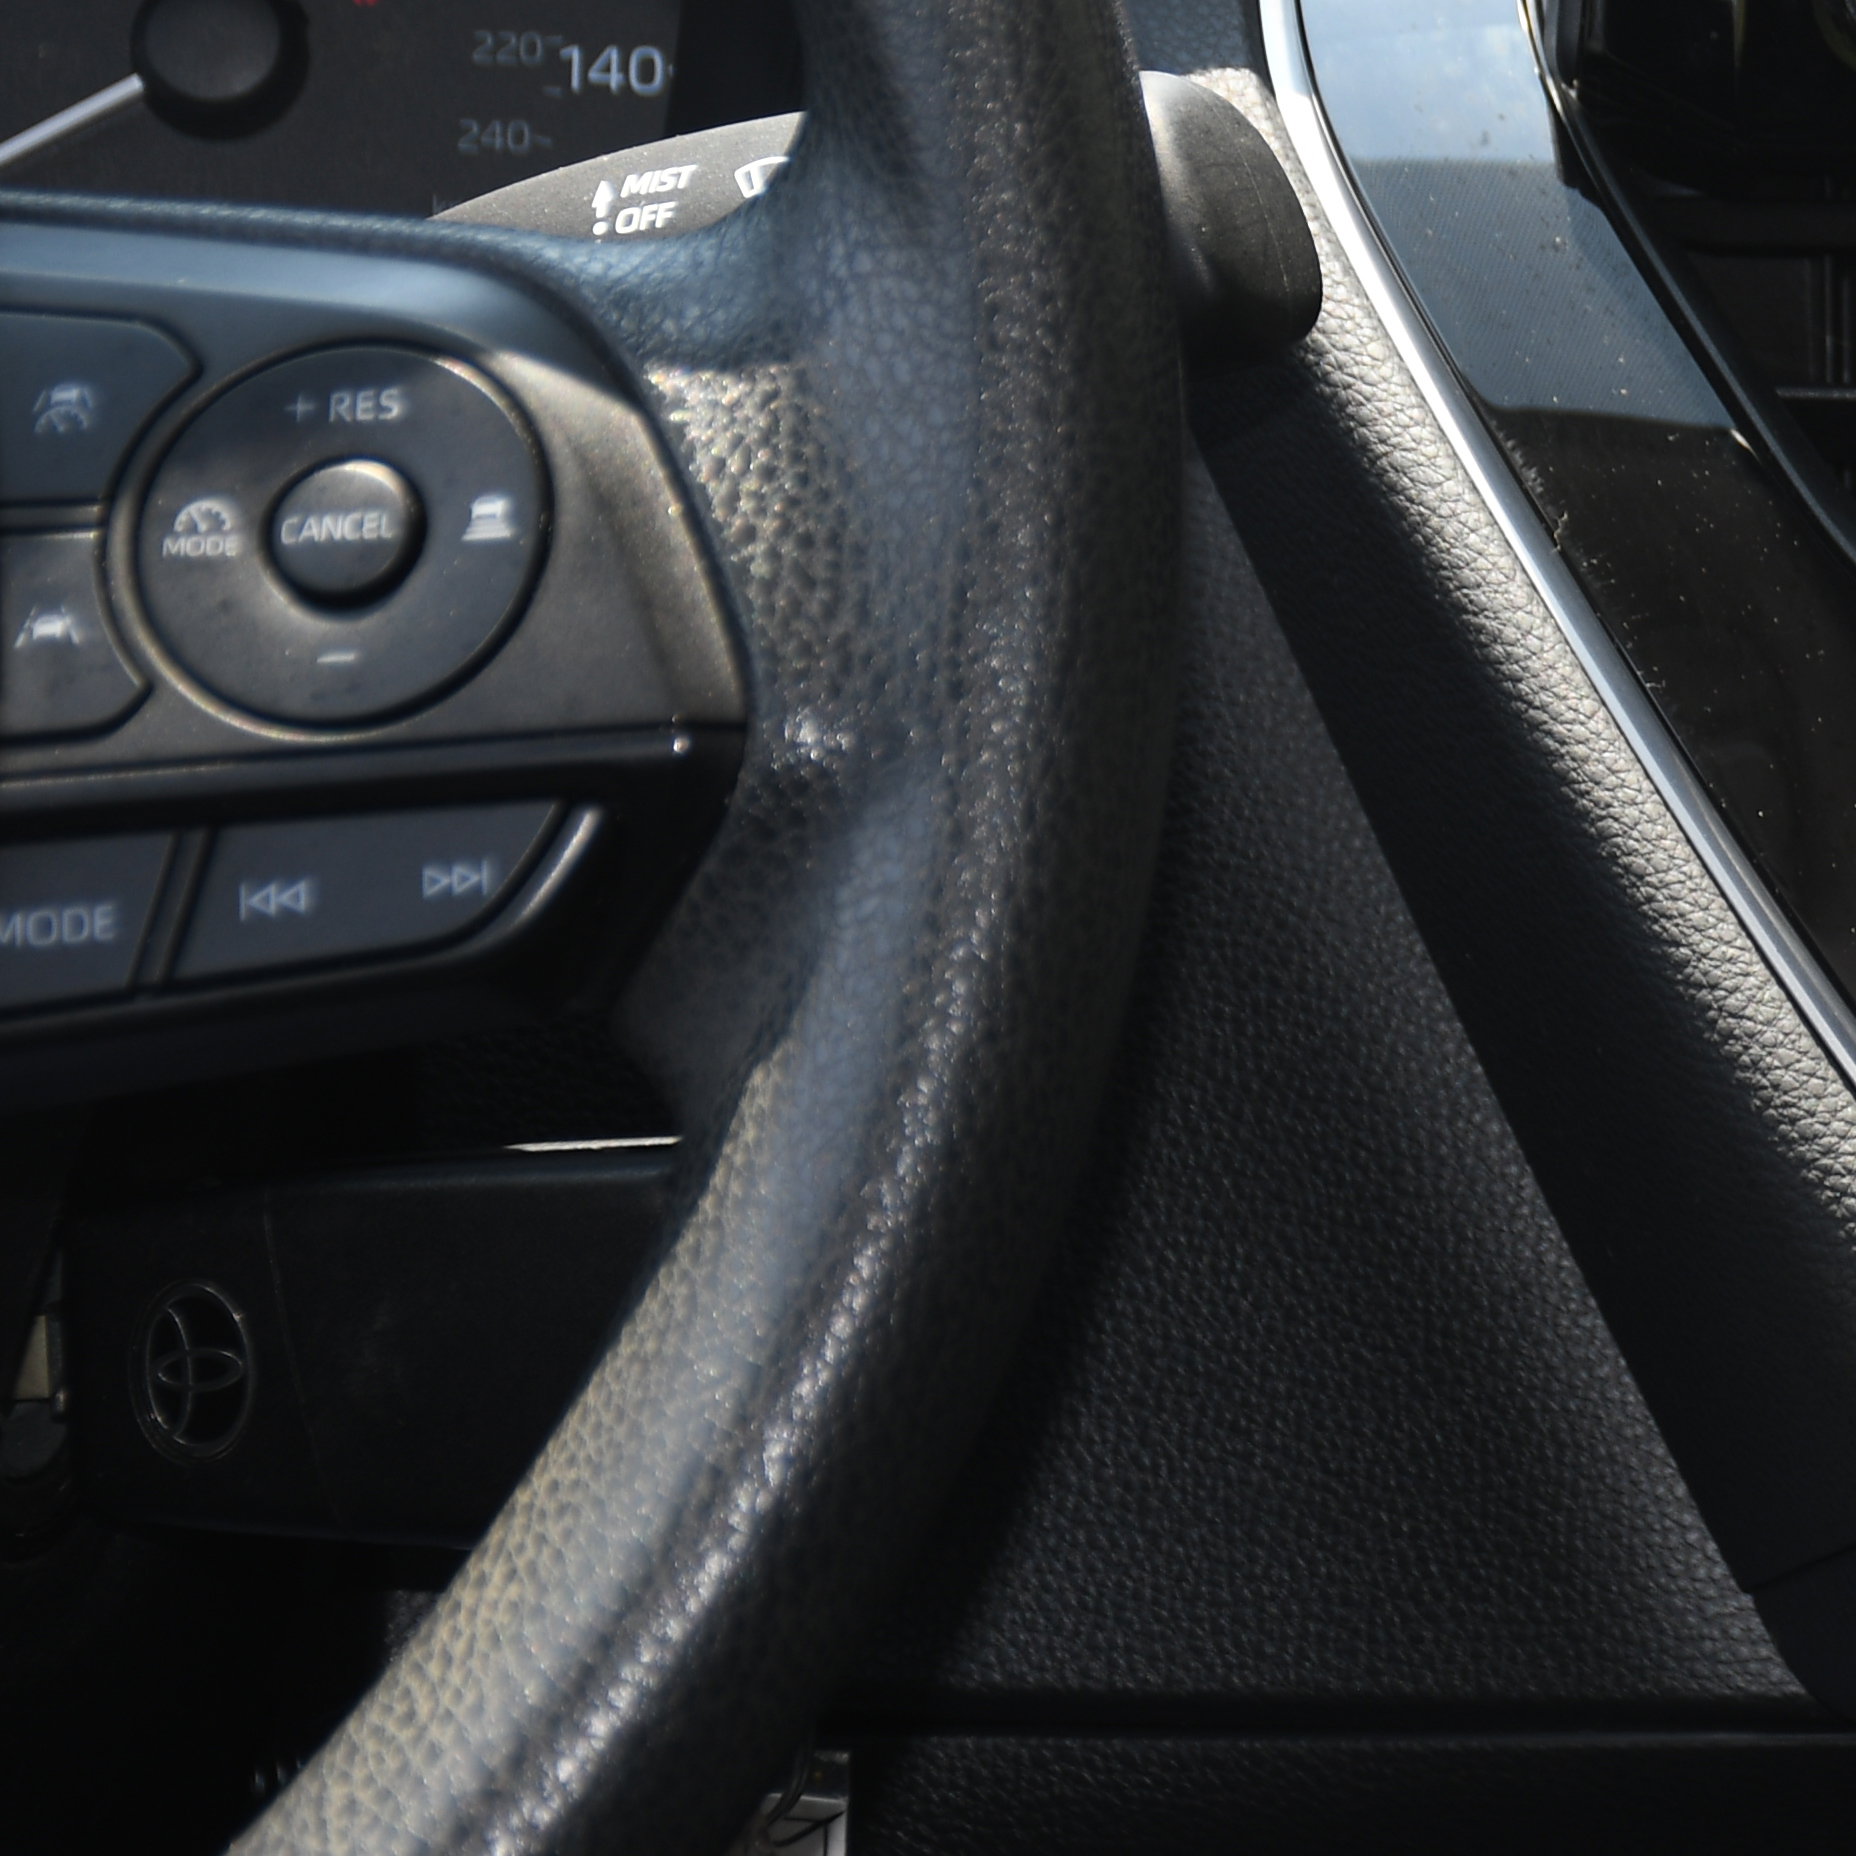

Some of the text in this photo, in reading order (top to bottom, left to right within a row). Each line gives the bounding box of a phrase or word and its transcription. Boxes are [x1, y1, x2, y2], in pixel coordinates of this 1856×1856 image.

[473, 32, 543, 63] 220
[561, 46, 663, 93] 140
[458, 121, 531, 151] 240
[621, 164, 699, 196] MIST
[615, 200, 678, 233] OFF
[329, 387, 406, 422] RES
[282, 510, 395, 543] CANCEL
[164, 534, 241, 556] MODE
